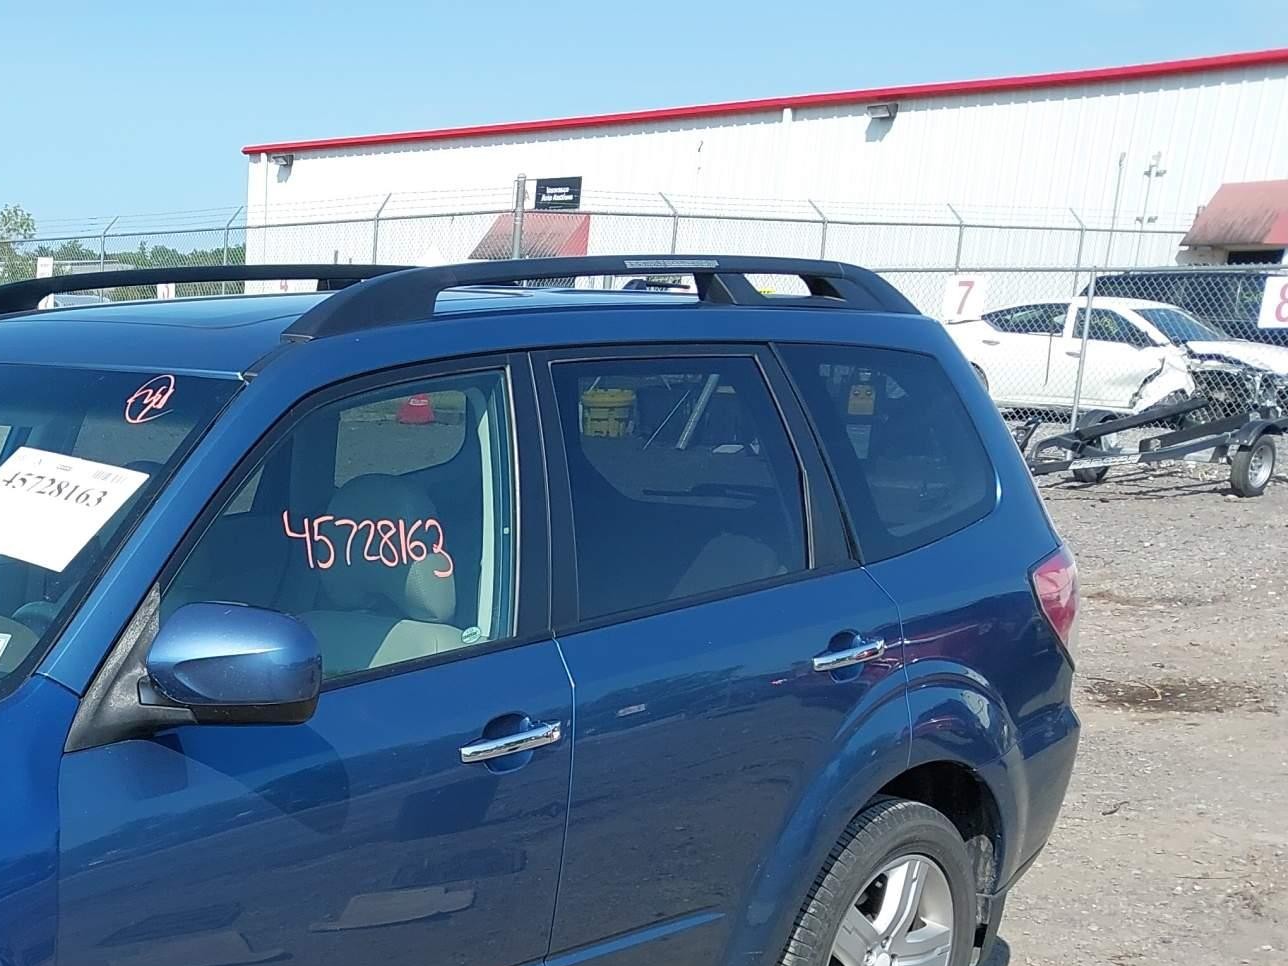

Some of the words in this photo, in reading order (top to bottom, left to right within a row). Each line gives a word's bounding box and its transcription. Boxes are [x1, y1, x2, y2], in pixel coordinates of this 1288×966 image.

[956, 281, 975, 315] 7
[2, 472, 108, 507] 45728163
[282, 510, 455, 578] 45728163
